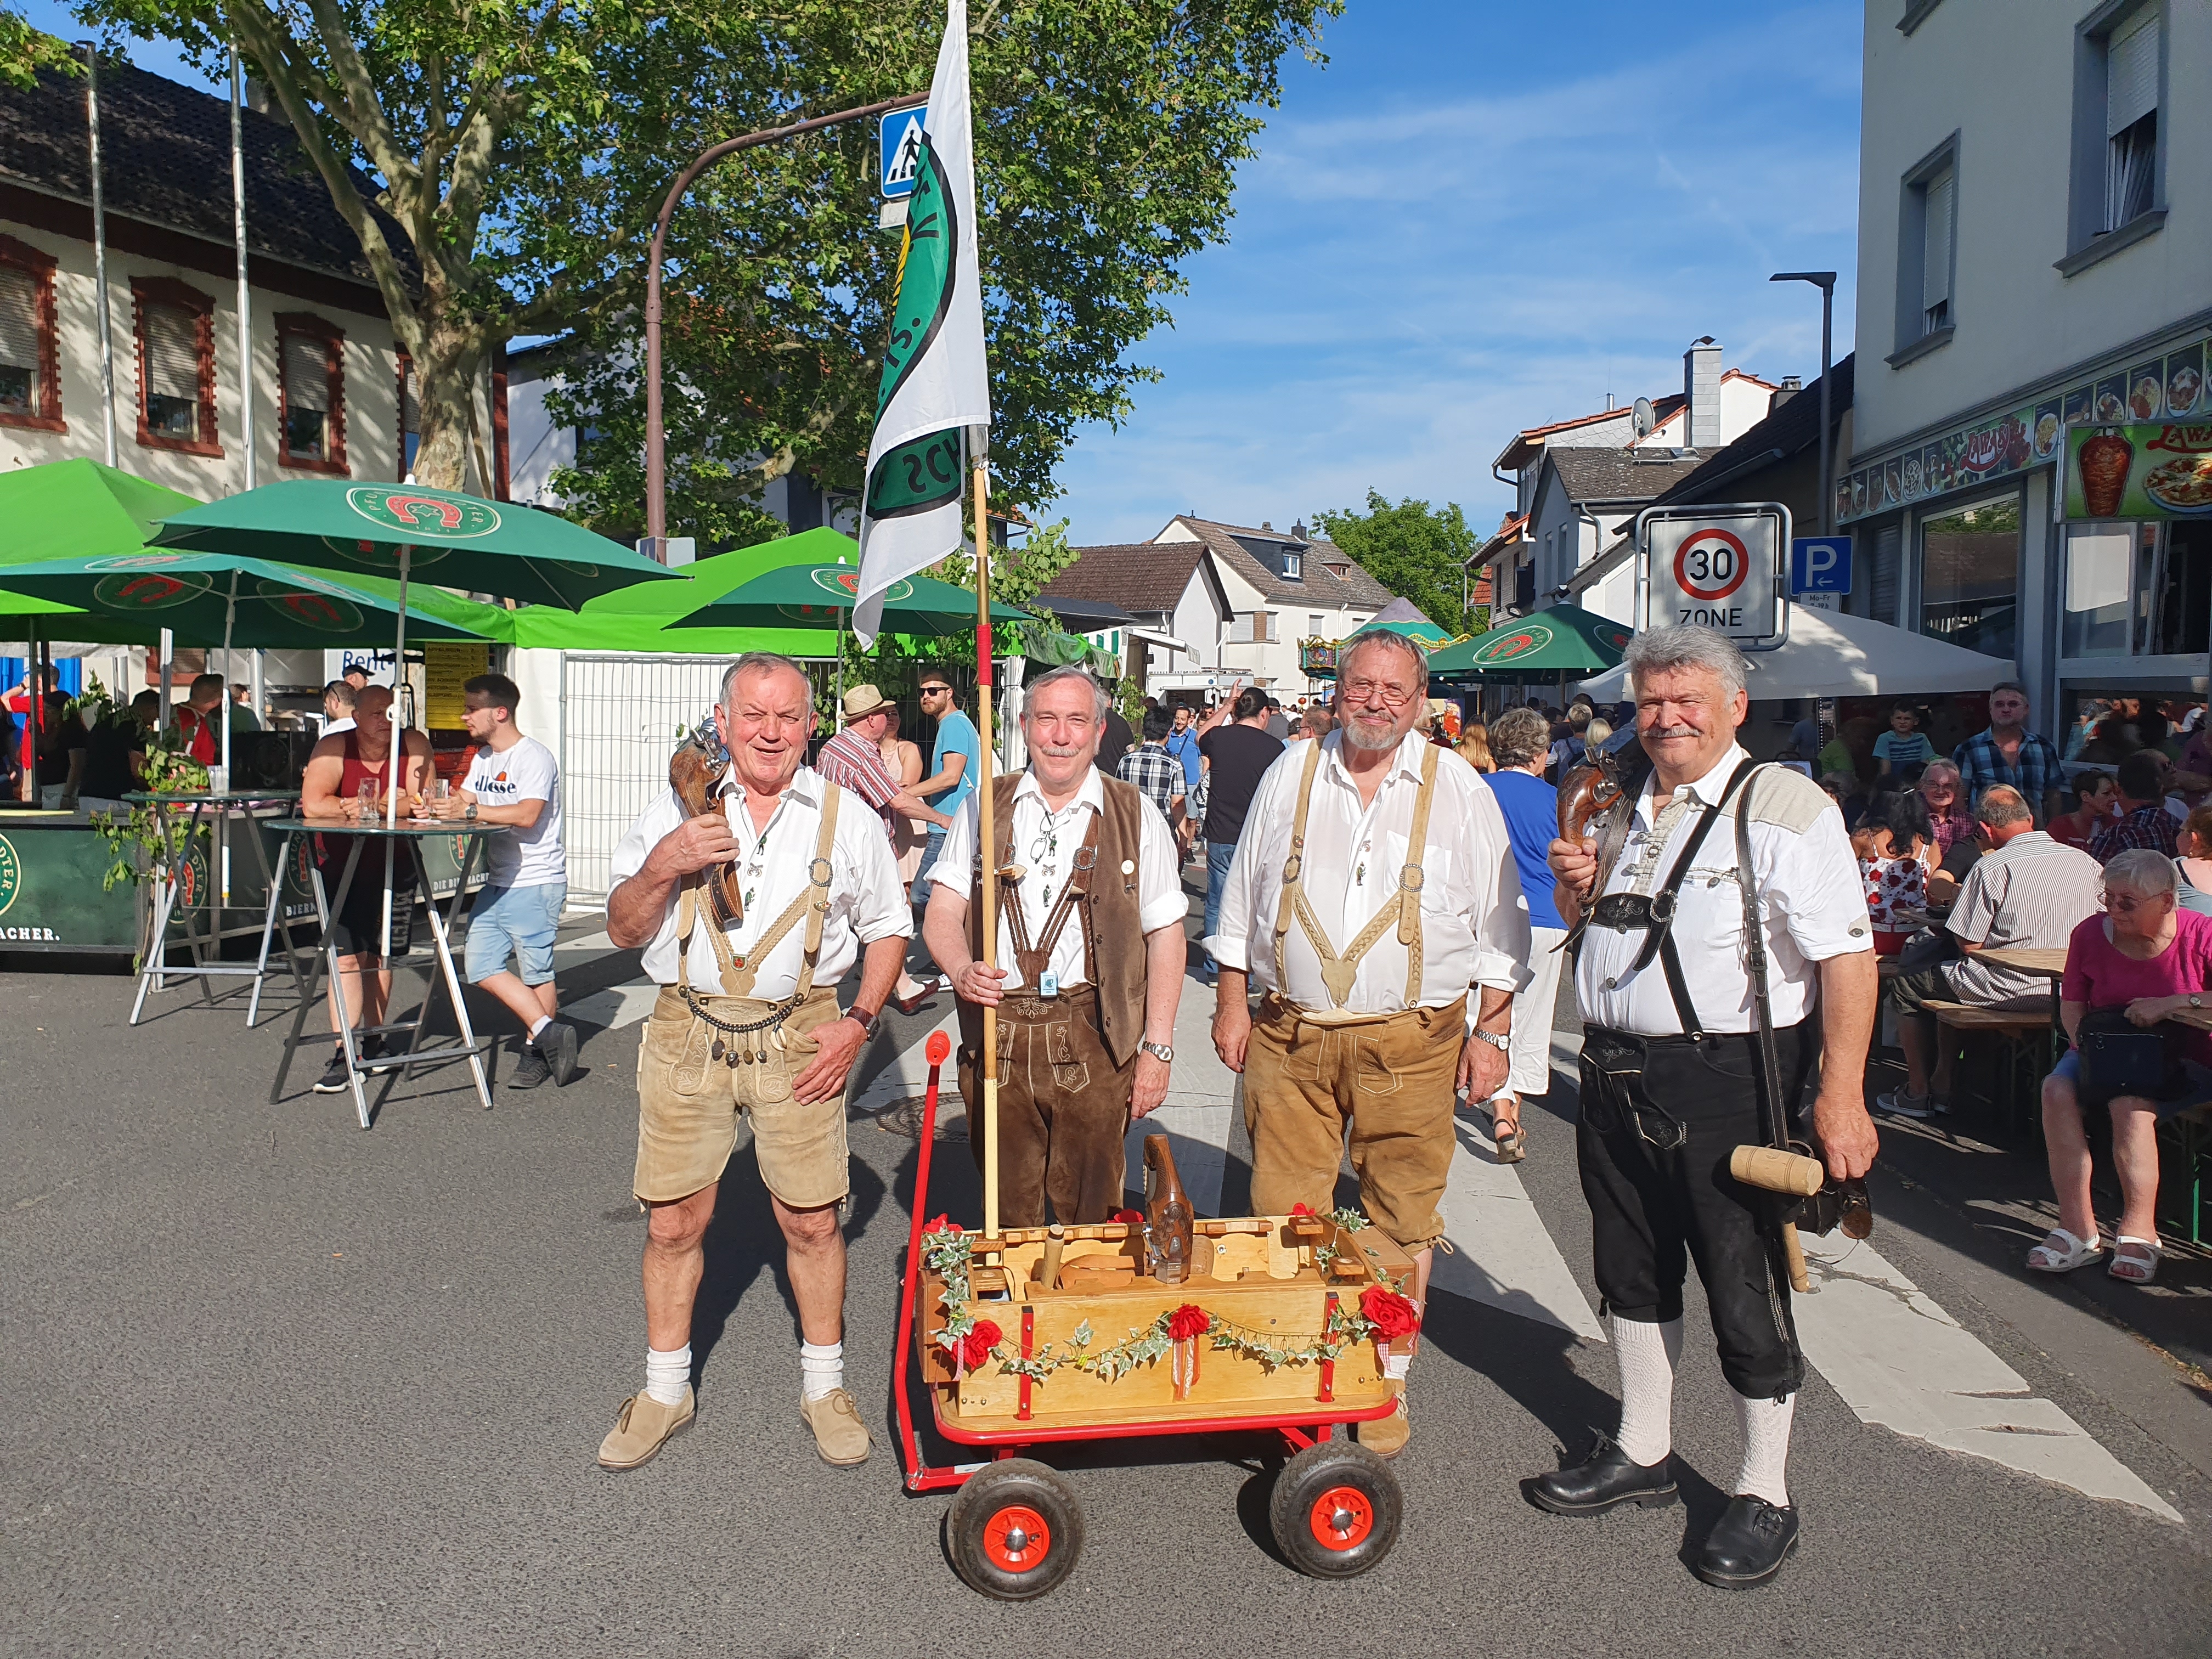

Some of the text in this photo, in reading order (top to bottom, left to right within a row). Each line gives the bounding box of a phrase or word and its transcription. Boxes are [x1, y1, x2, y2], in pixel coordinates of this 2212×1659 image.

[1689, 548, 1732, 580] 30
[1805, 545, 1837, 588] P
[1679, 608, 1742, 627] ZONE
[433, 879, 447, 891] DIE
